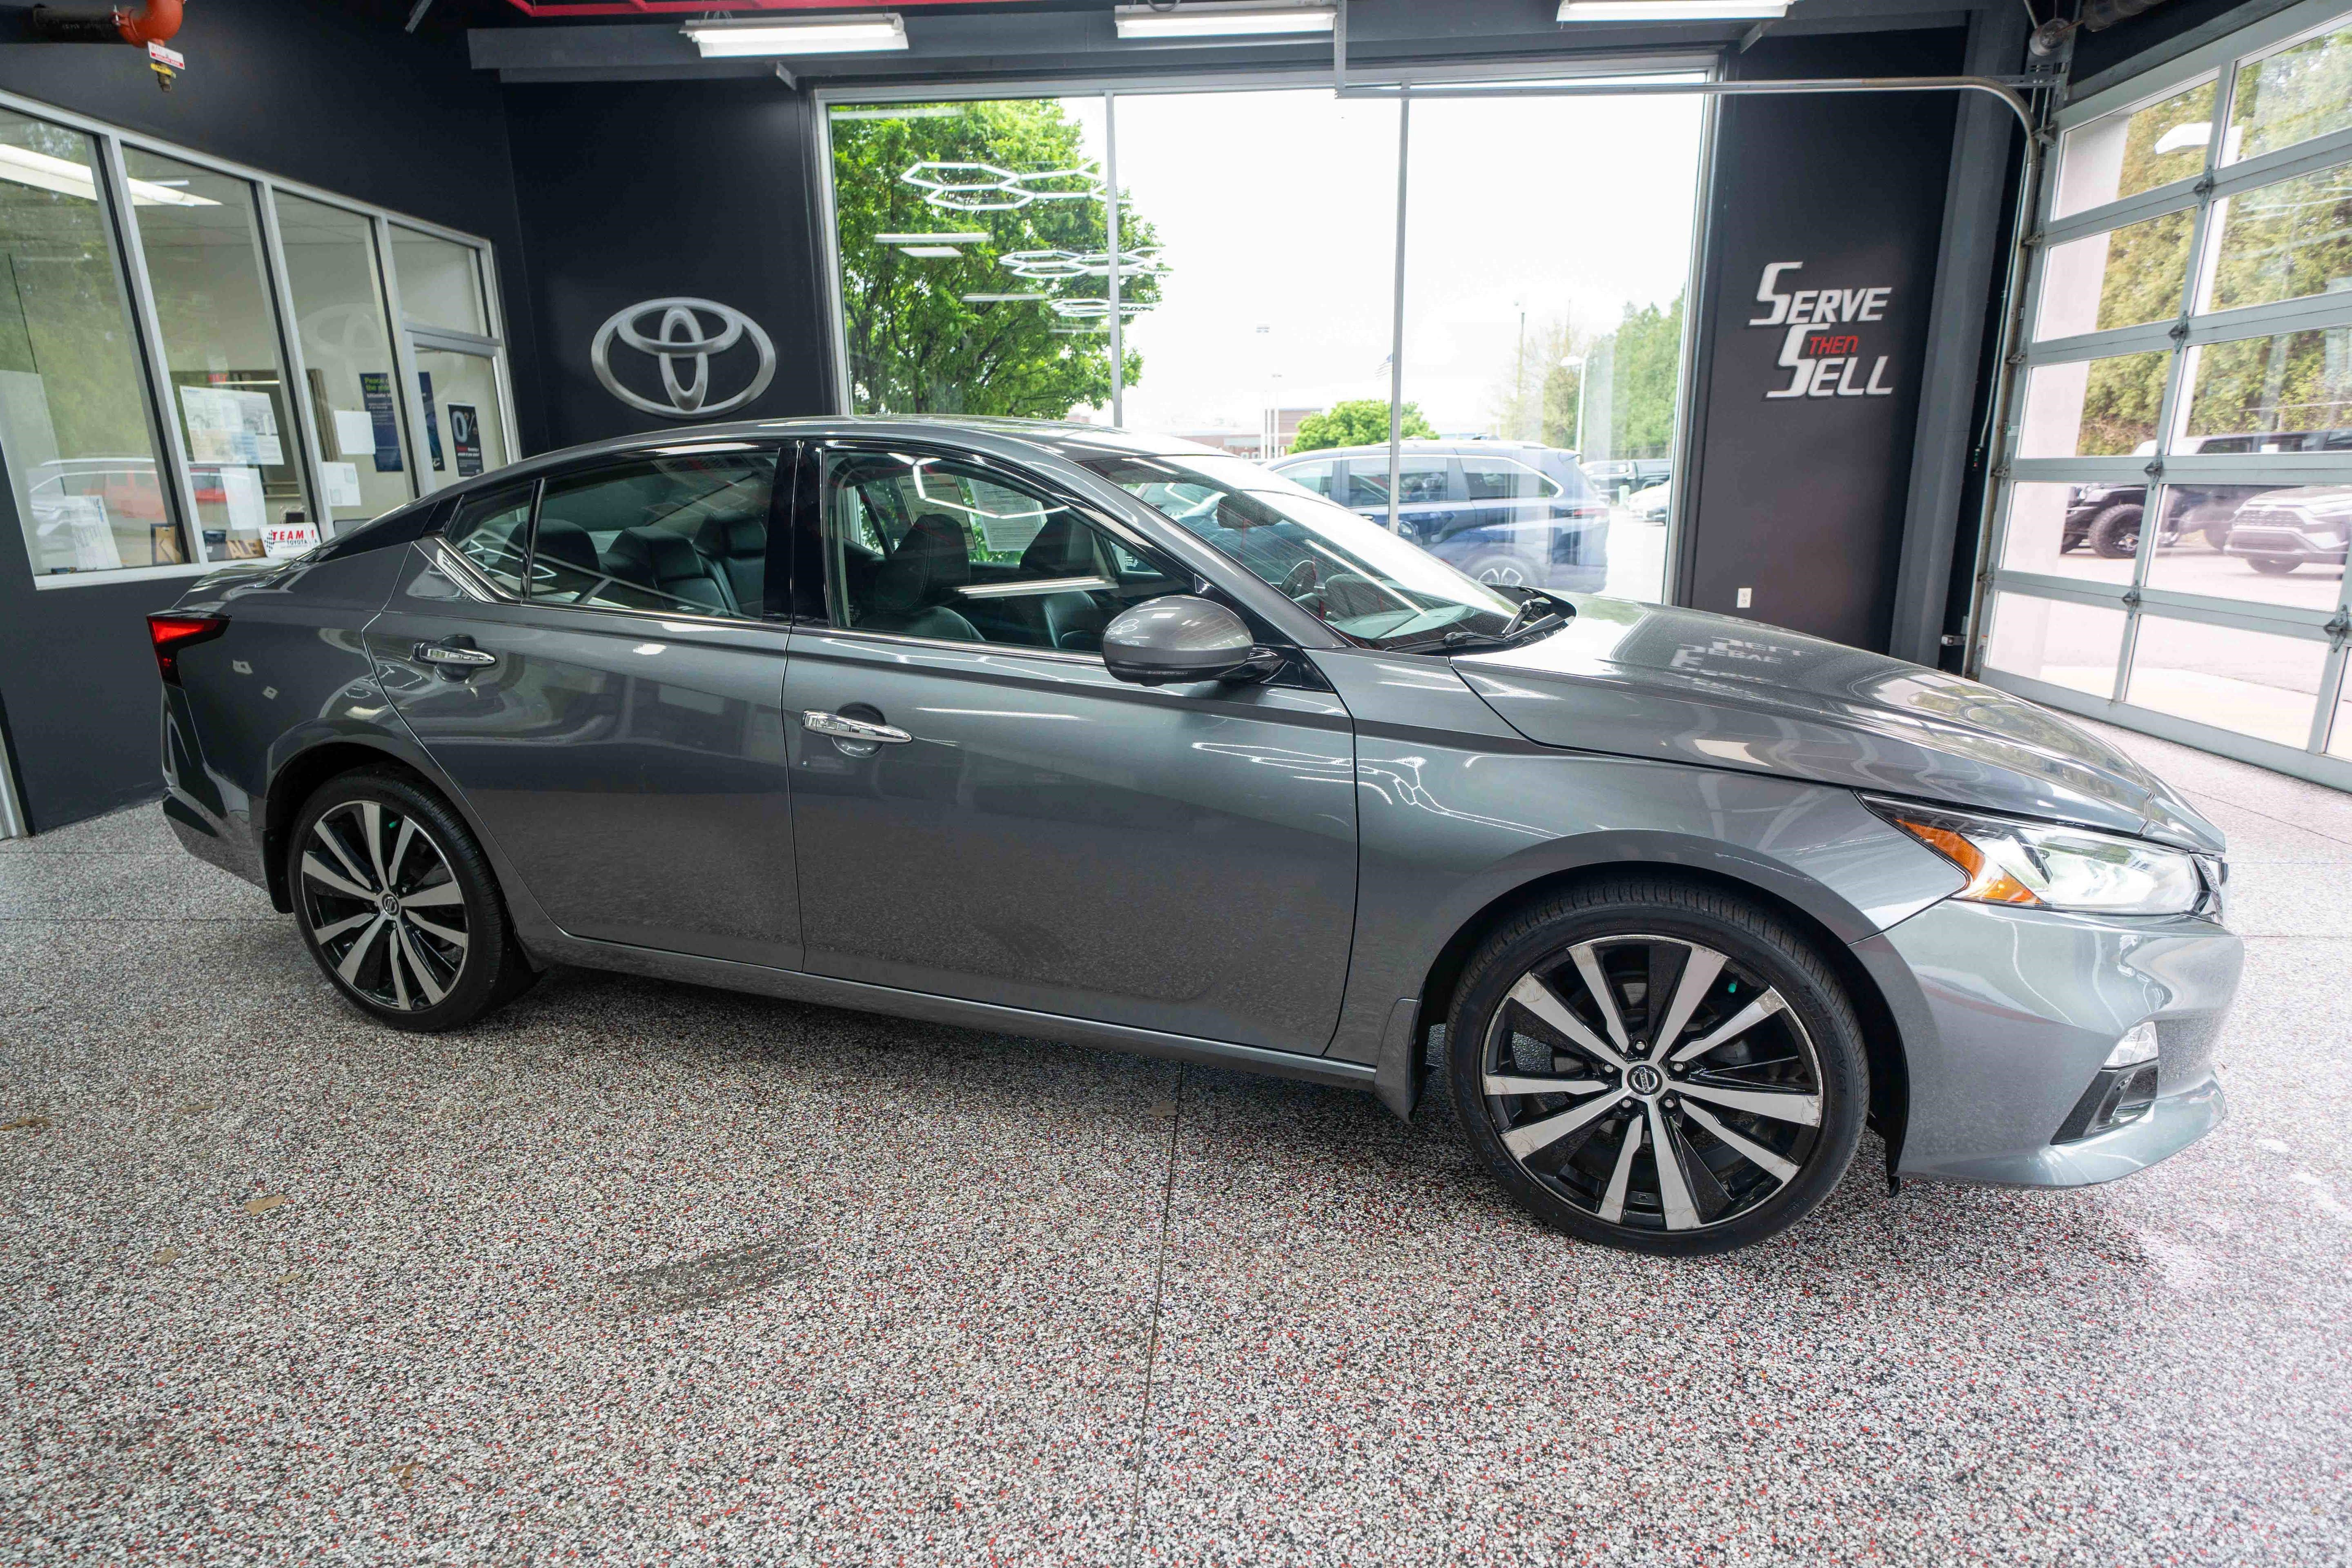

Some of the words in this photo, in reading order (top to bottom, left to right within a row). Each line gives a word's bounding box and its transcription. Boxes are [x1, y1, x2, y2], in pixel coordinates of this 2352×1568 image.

[1748, 261, 1892, 326] SERVE
[1766, 323, 1893, 398] SELL
[272, 530, 304, 540] TEAM
[1640, 1071, 1649, 1091] NISSAN
